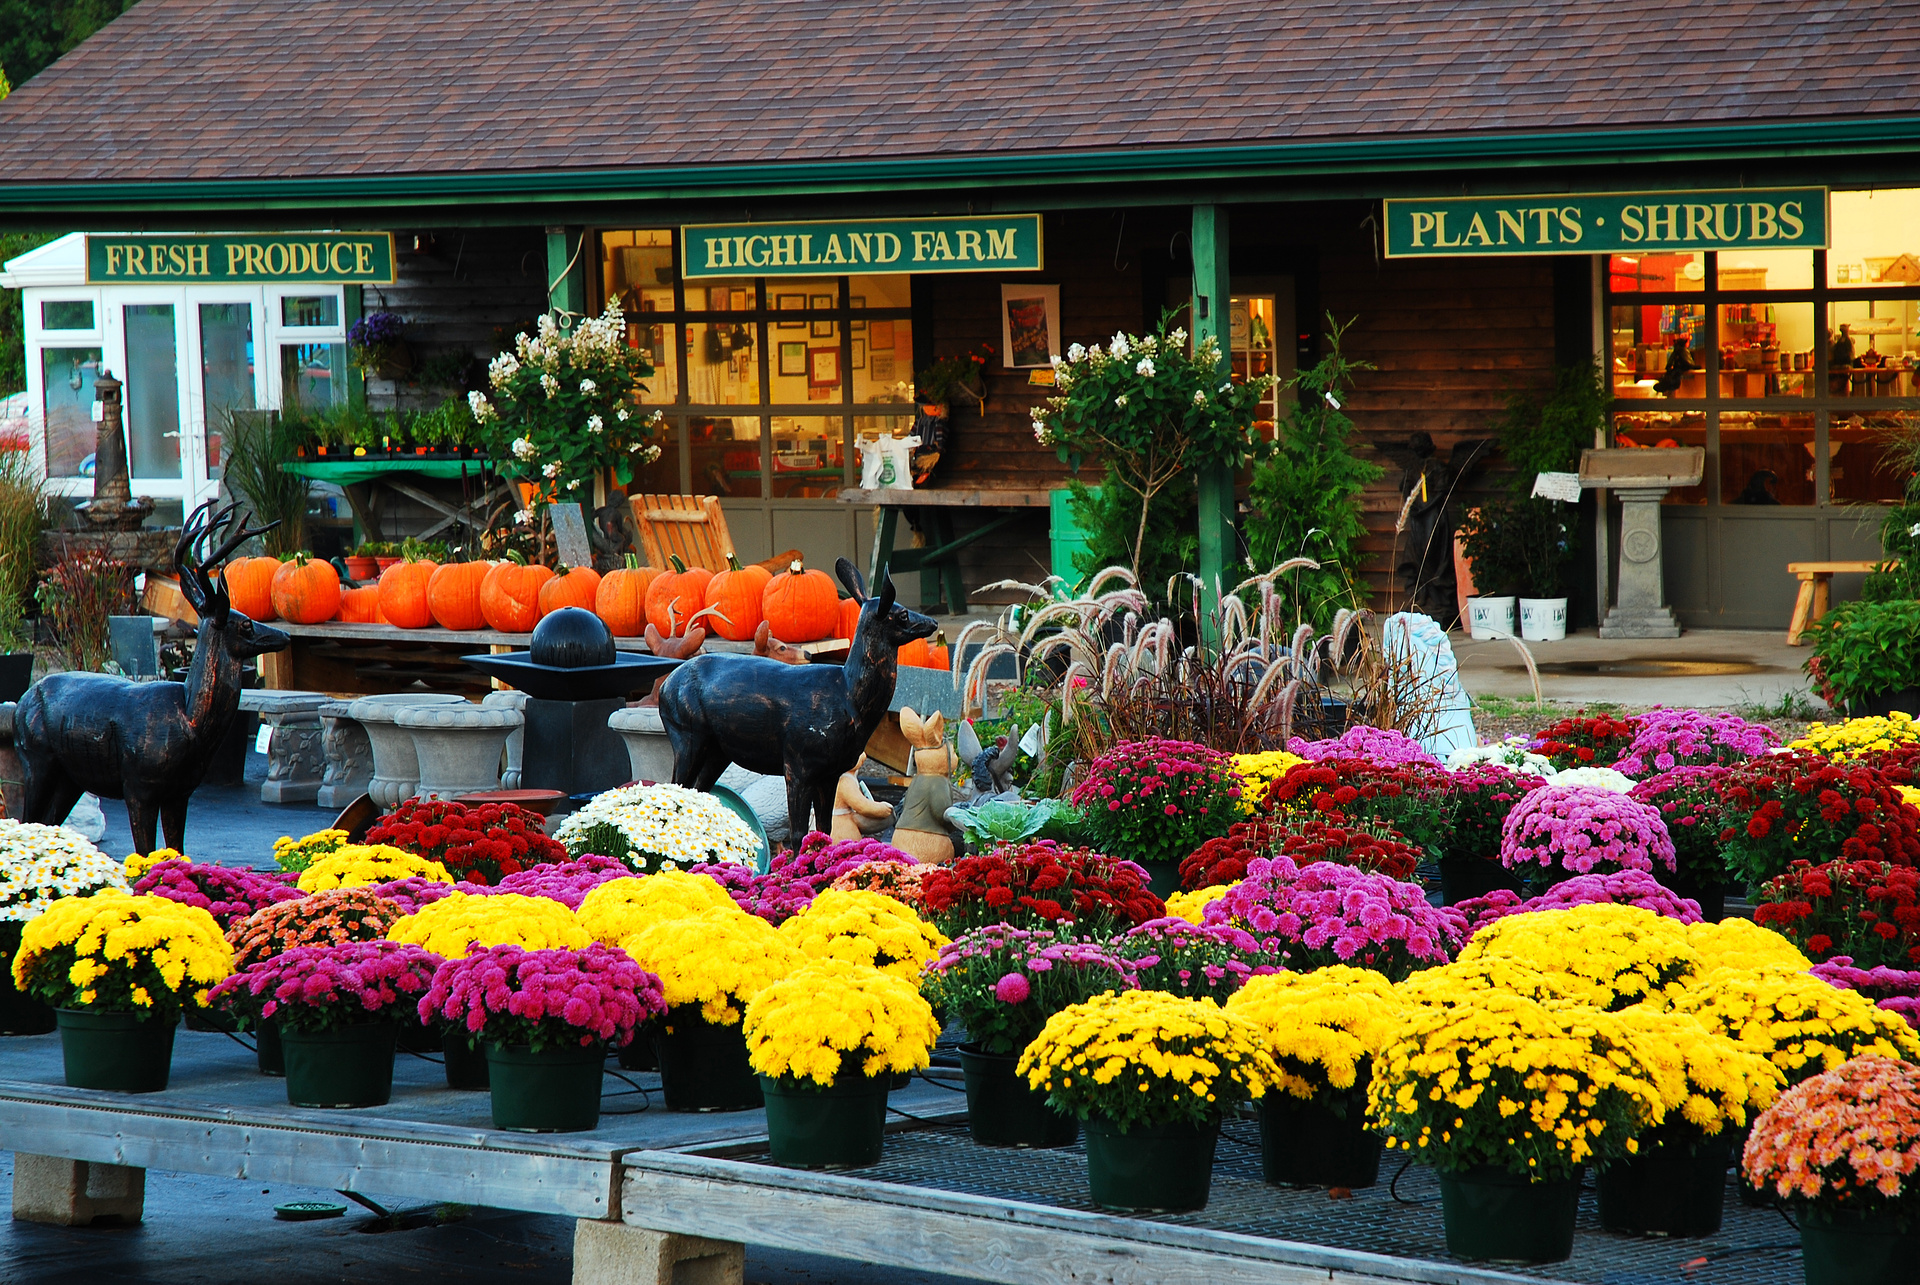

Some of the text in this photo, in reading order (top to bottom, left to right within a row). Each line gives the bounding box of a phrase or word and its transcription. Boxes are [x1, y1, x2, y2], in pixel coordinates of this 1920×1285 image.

[1410, 201, 1805, 247] PLANTS SHRUBS
[105, 242, 375, 276] FRESH PRODUCE
[704, 227, 1018, 269] HIGHLAND FARM
